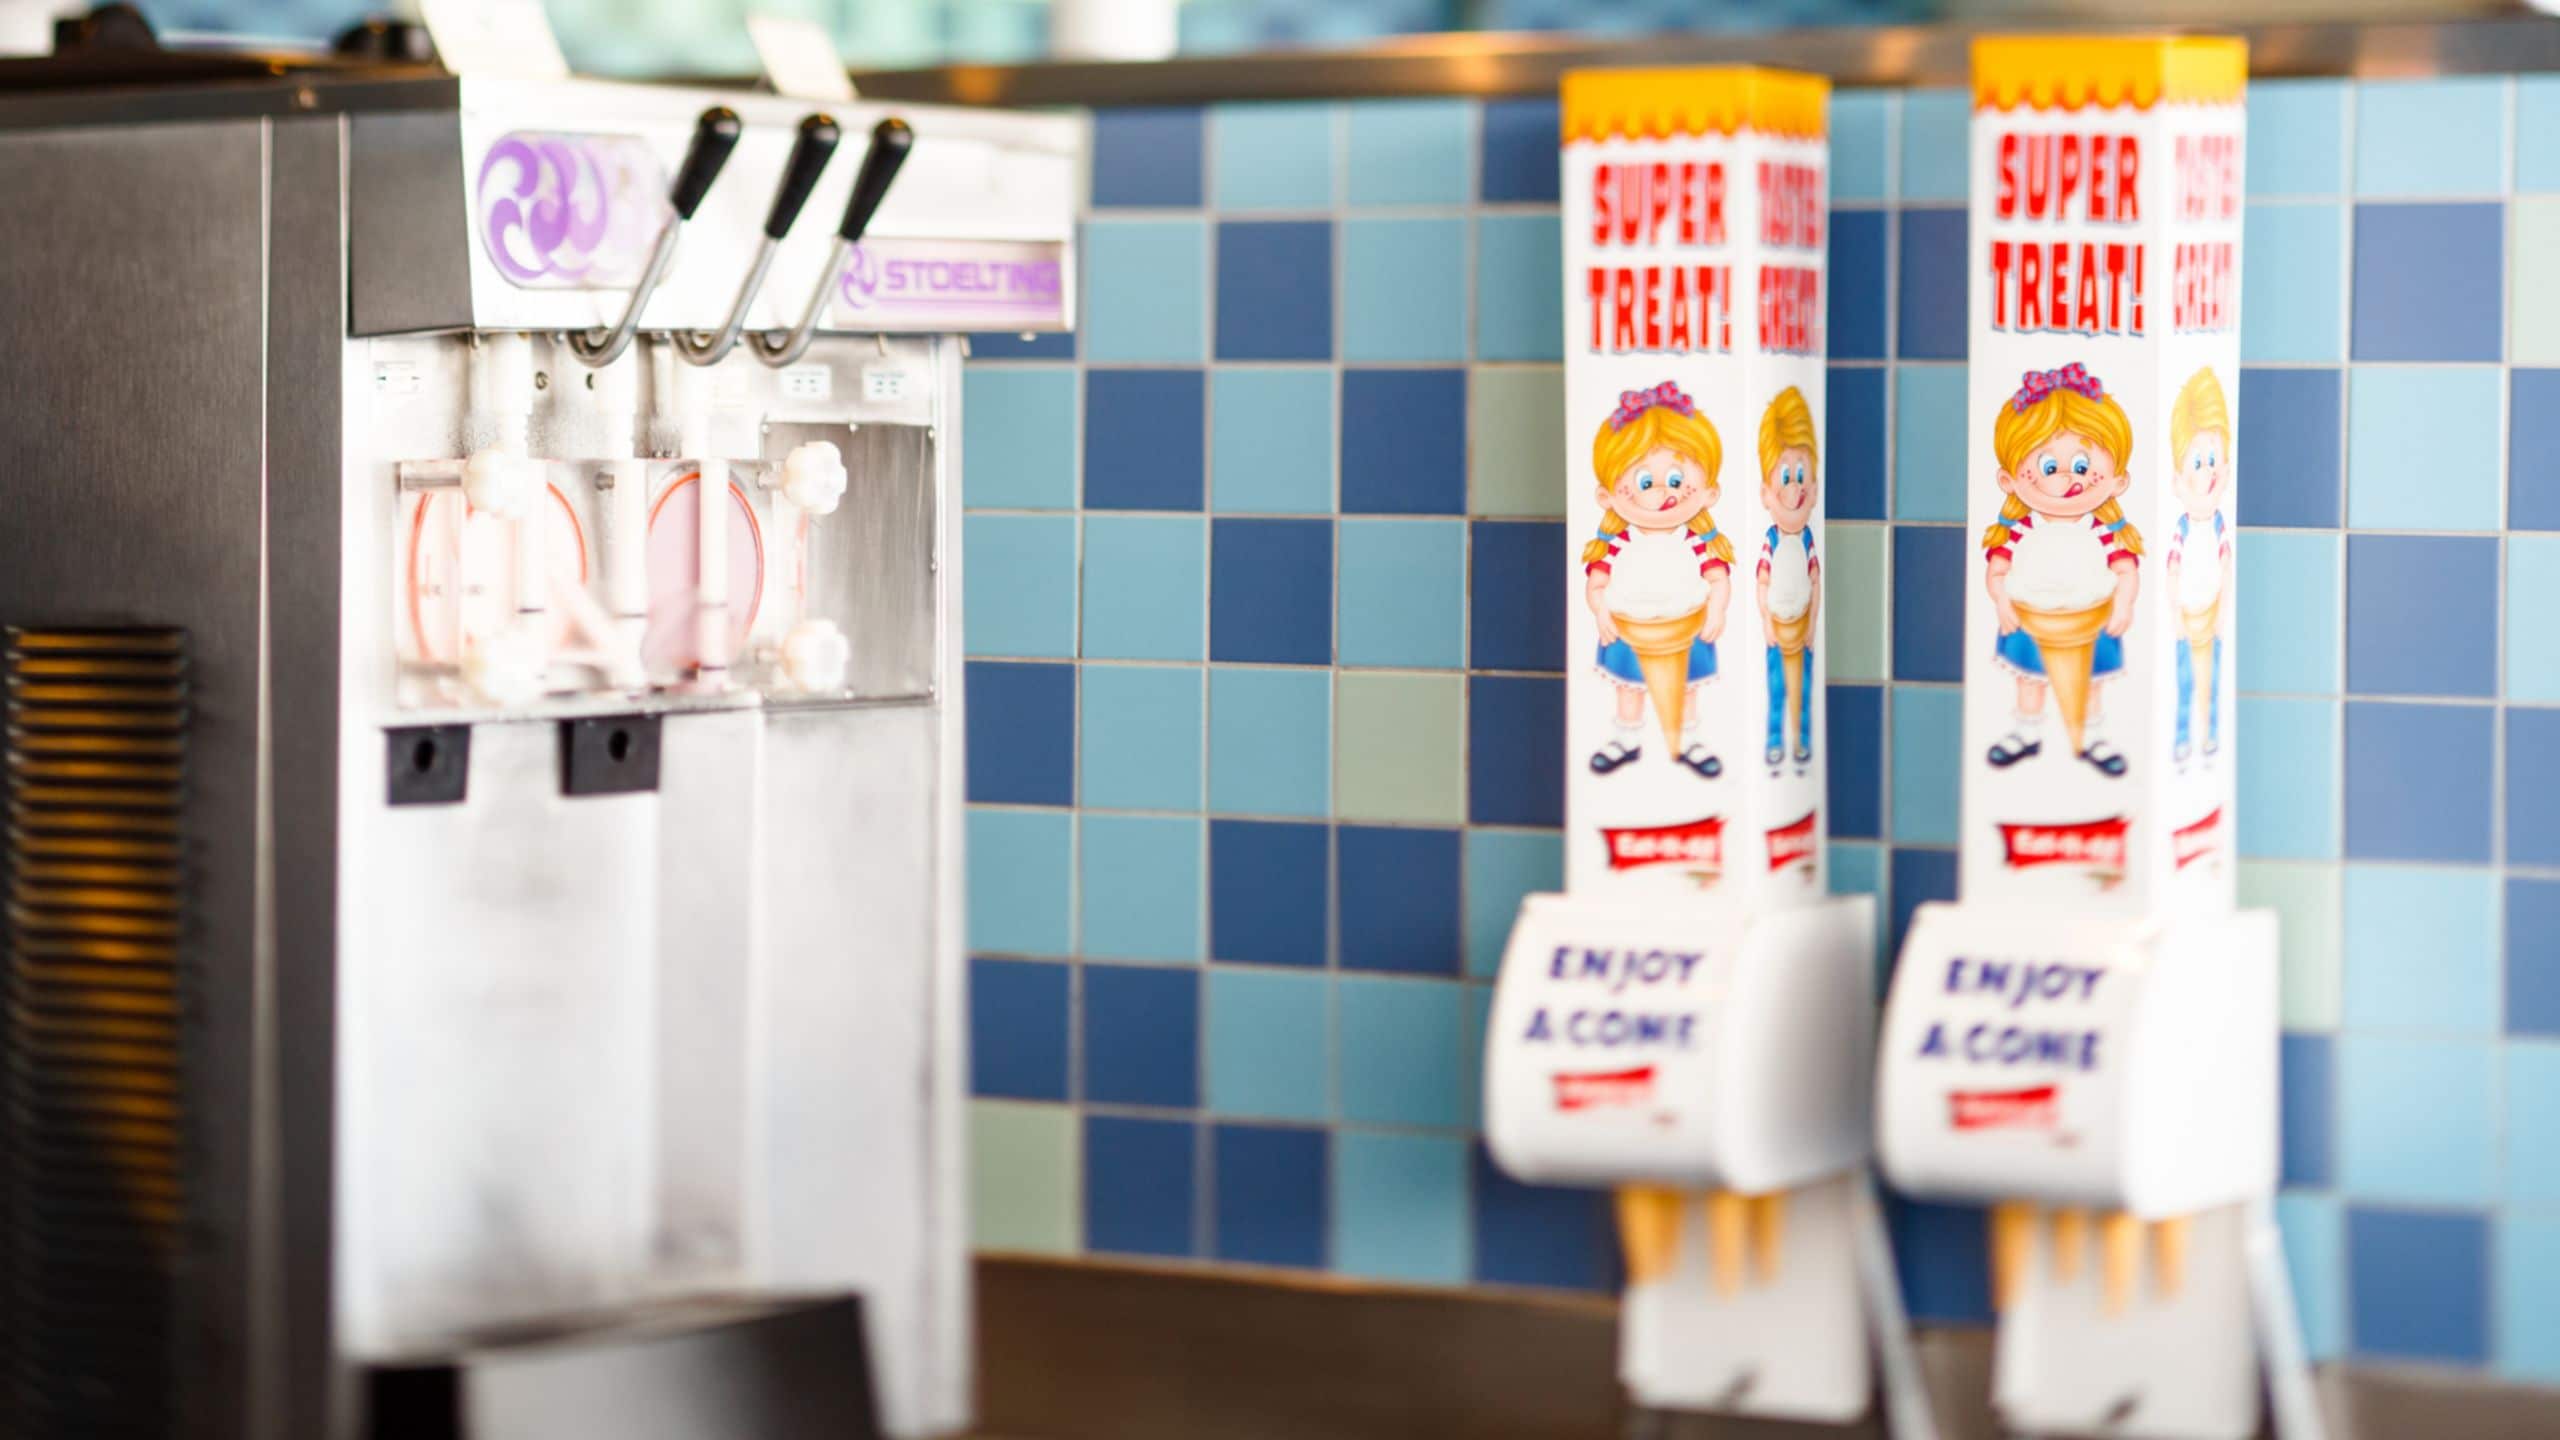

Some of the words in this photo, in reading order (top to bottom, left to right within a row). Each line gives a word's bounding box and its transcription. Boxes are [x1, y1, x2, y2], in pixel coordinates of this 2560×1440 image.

[1996, 132, 2140, 225] SUPER
[1591, 162, 1727, 248] SUPER
[884, 259, 1062, 294] STOELTING
[1989, 240, 2145, 337] TREAT!
[1585, 264, 1731, 354] TREAT!
[1548, 946, 1704, 994] ENJOY
[1944, 957, 2106, 1008] ENJOY
[1523, 1007, 1551, 1042] A
[1918, 1022, 1947, 1058] A
[1964, 1023, 2101, 1070] CONE
